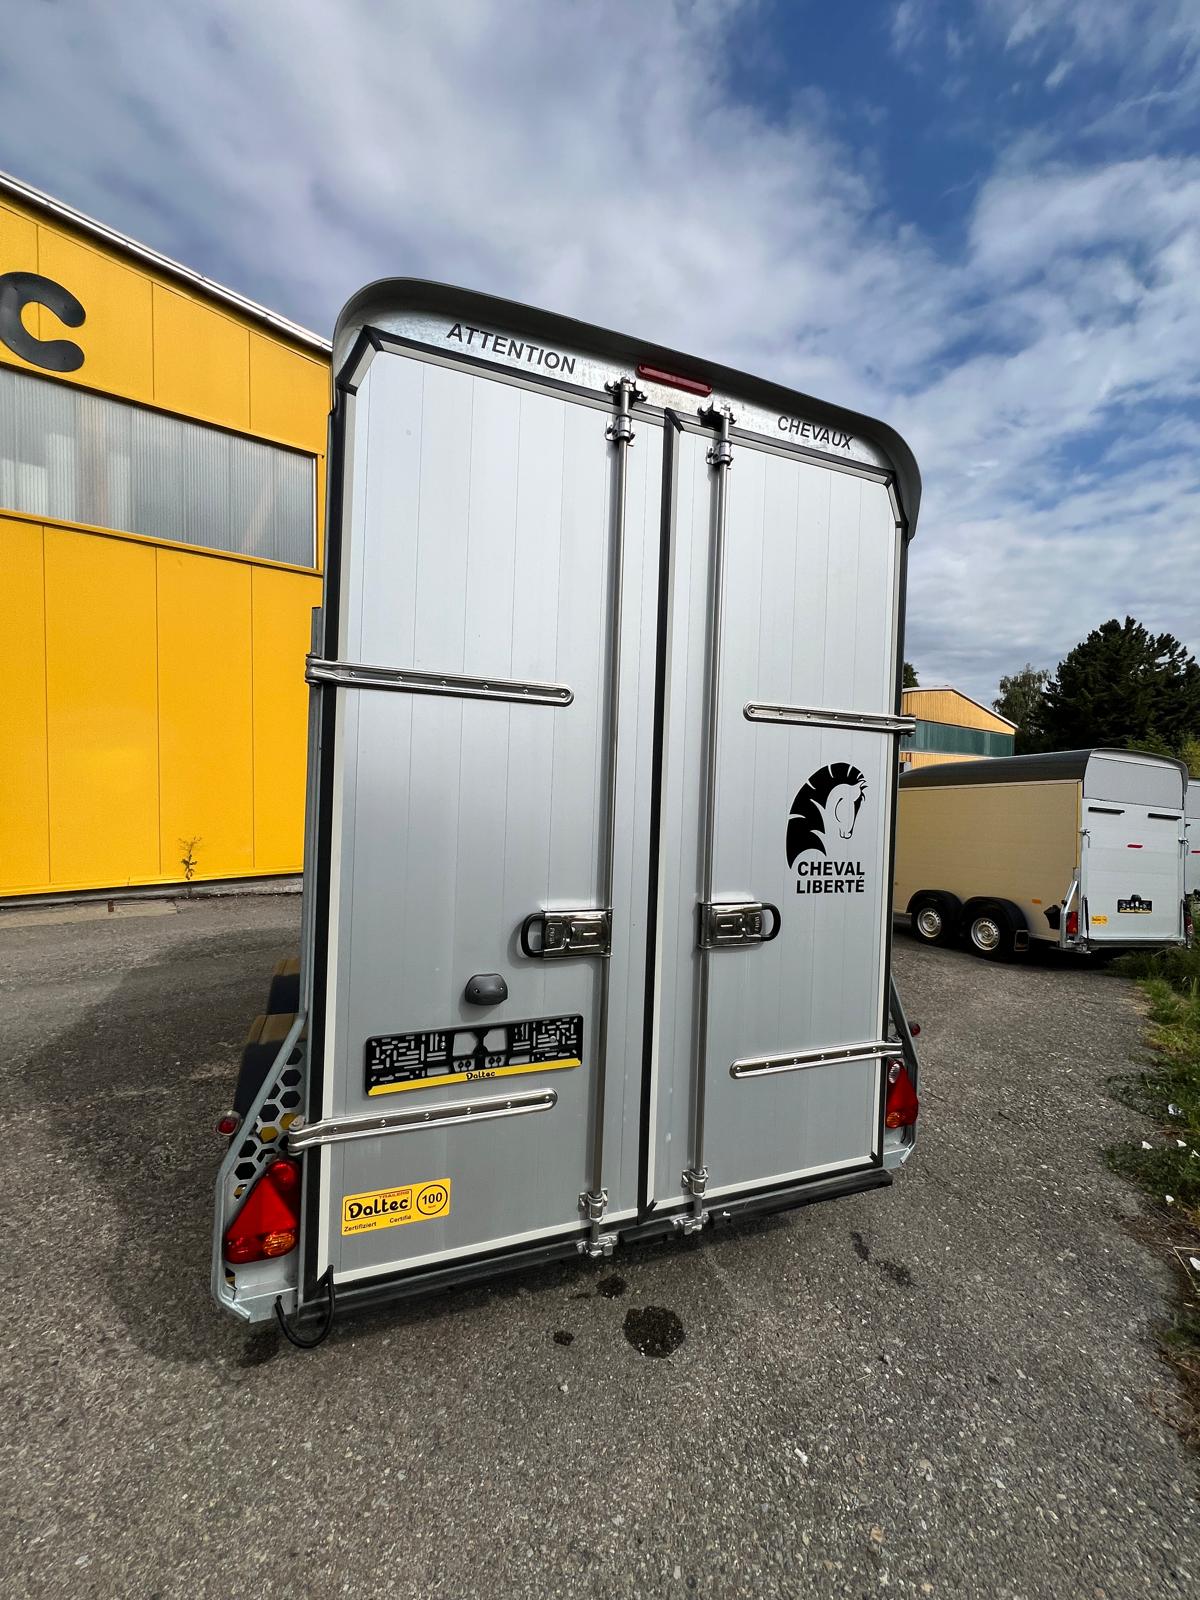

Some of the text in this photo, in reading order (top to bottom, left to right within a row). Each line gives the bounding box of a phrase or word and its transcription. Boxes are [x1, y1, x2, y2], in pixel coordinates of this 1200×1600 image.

[446, 323, 576, 374] ATTENTION
[777, 415, 853, 451] CHEVAUX
[797, 861, 865, 876] CHEVAL
[796, 876, 865, 894] LIBERTÉ
[422, 1192, 443, 1205] 100
[348, 1198, 408, 1219] Daltec
[343, 1221, 377, 1232] Zertifiziert
